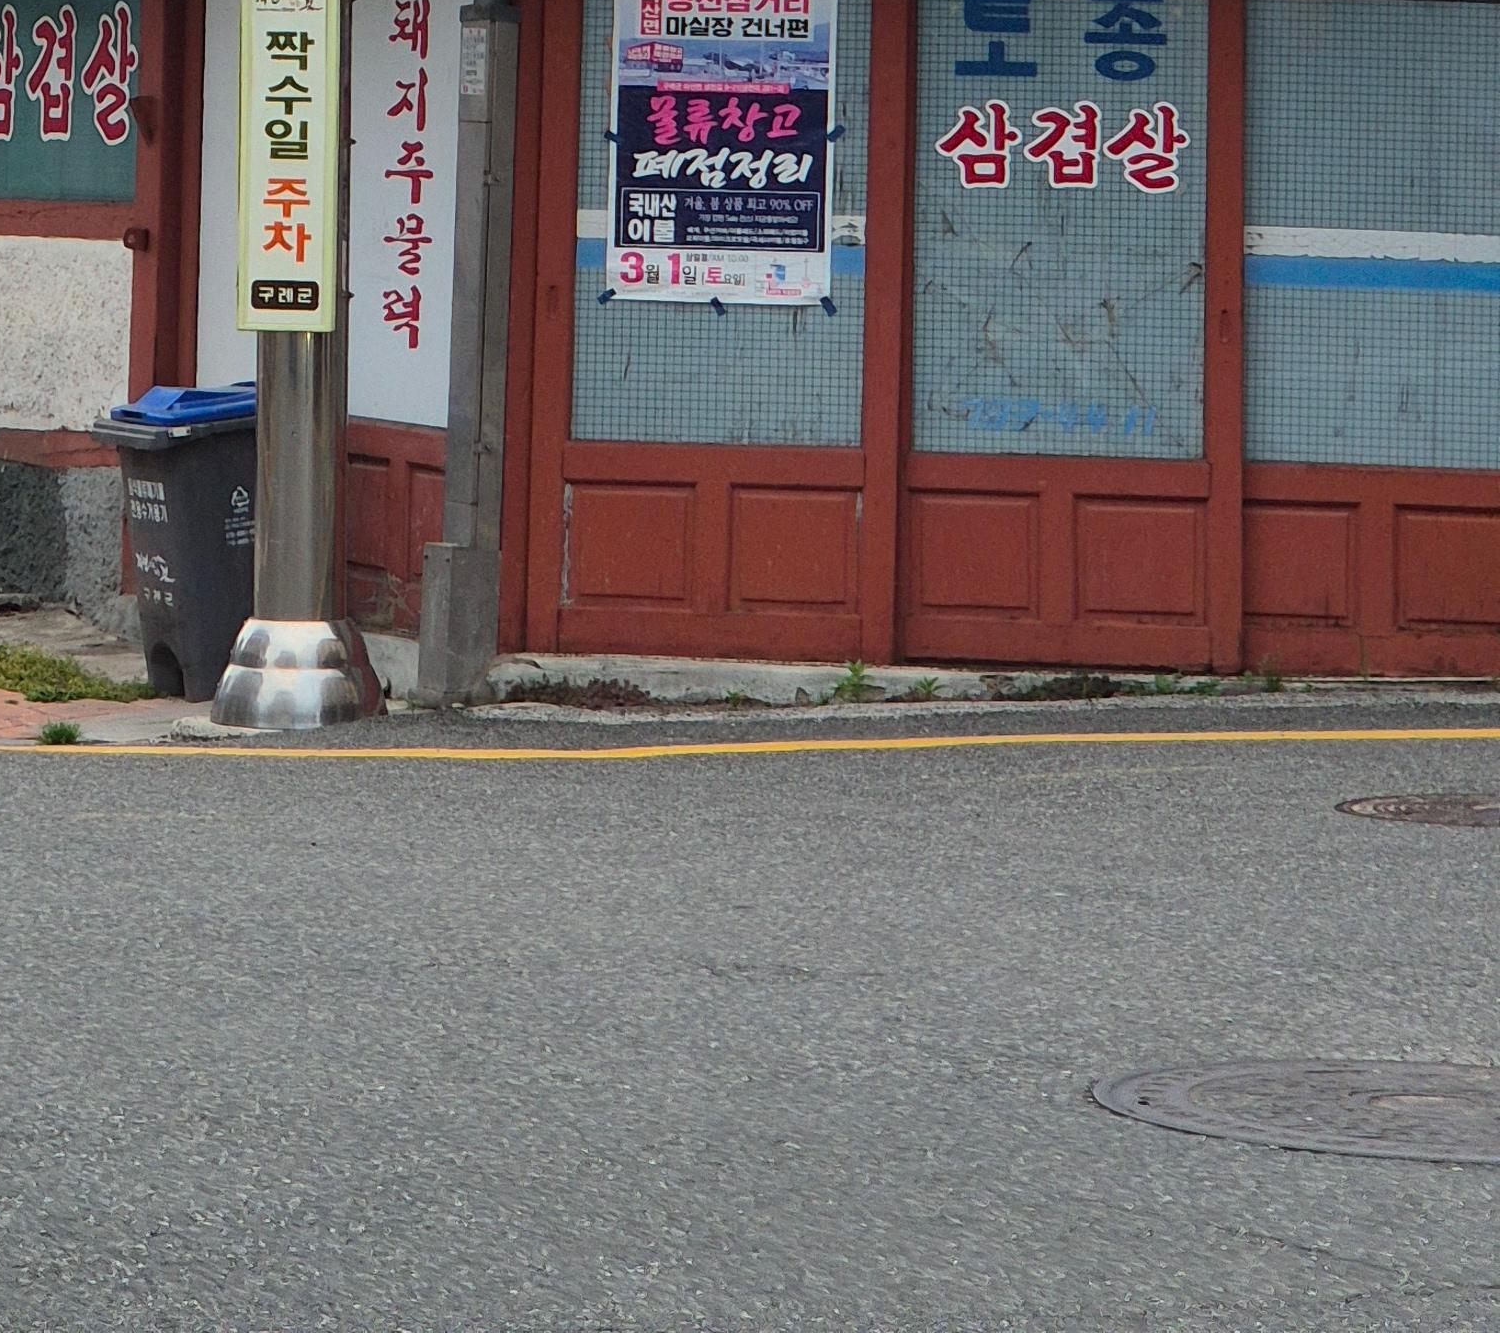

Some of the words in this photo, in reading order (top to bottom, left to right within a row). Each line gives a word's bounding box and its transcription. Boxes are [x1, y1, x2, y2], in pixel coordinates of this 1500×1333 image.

[666, 17, 734, 38] 마실장
[741, 18, 810, 39] 건너편
[264, 30, 316, 162] 짝수일
[646, 95, 802, 145] 물류창고
[935, 100, 1190, 194] 삼겹살
[633, 148, 814, 189] 폐점정리
[262, 177, 312, 263] 주차
[628, 192, 677, 218] 국내산
[769, 198, 792, 211] 90%
[794, 199, 814, 212] OFF
[619, 251, 660, 286] 3월
[667, 251, 697, 287] 1일
[258, 286, 314, 305] 구례군
